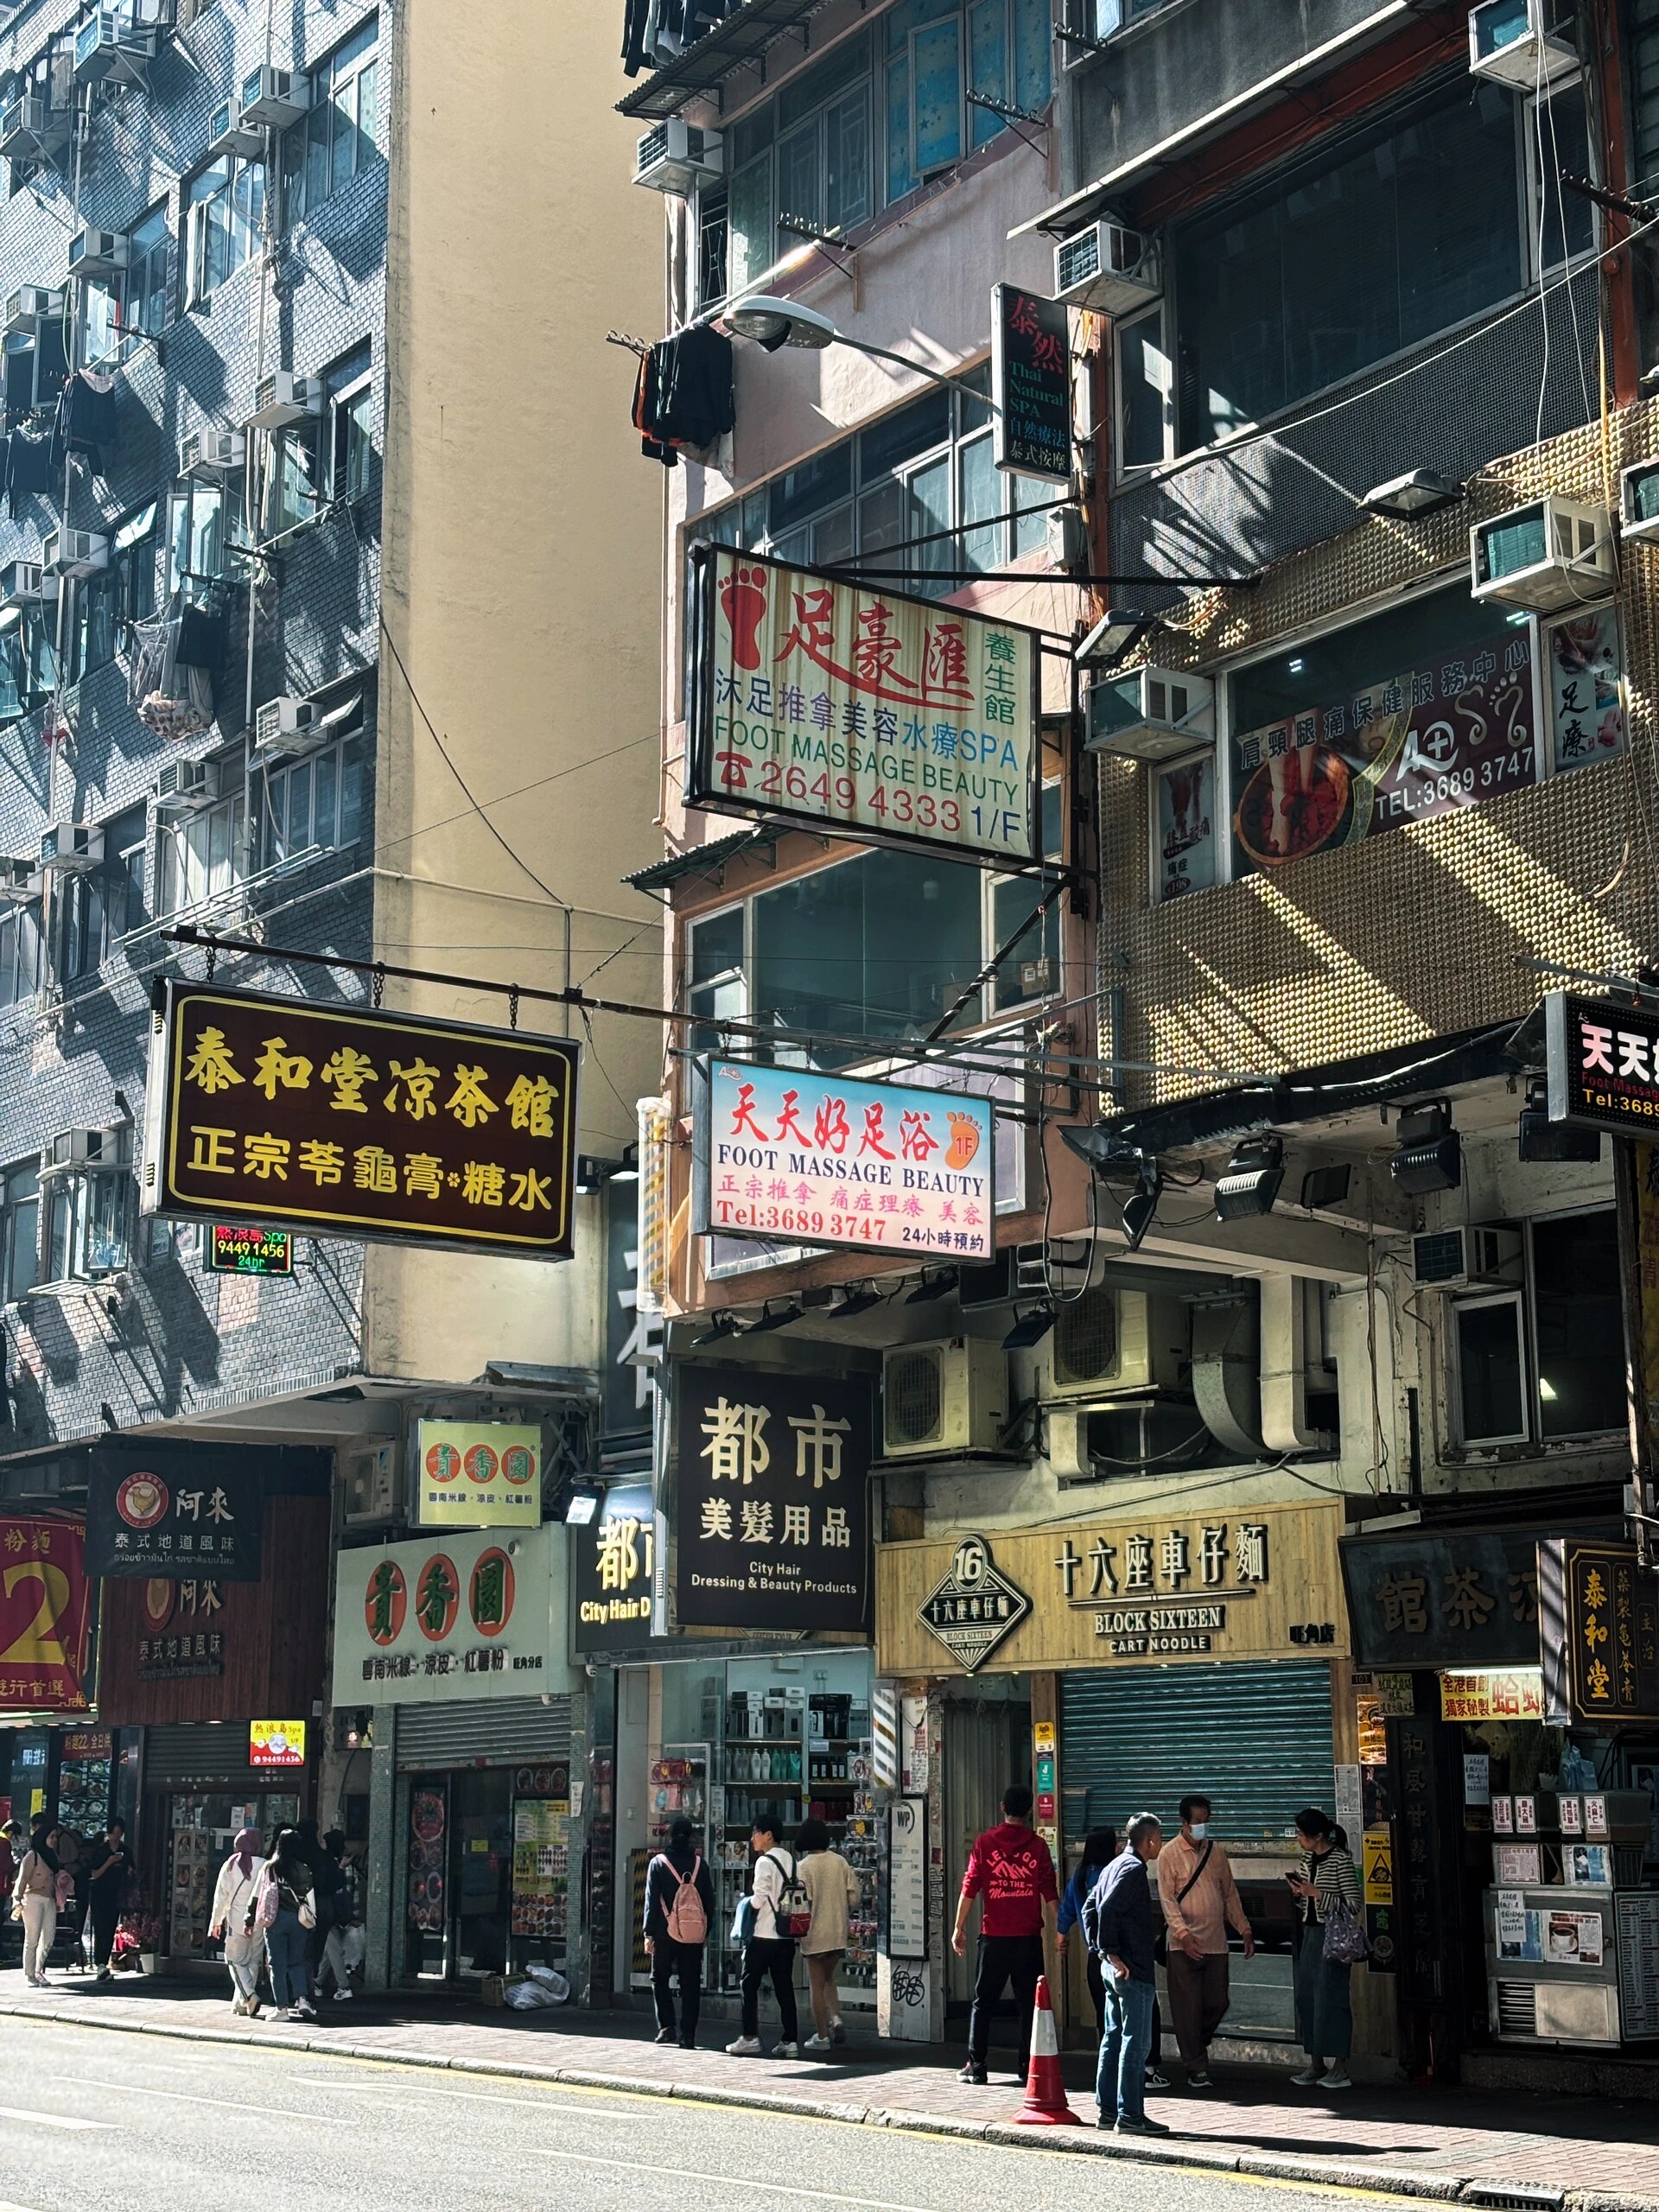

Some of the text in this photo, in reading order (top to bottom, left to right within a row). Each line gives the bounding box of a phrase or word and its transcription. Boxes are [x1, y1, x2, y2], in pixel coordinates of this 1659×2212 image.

[1007, 296, 1064, 374] 泰然
[1009, 360, 1042, 383] Thai
[1009, 379, 1064, 407] Natural
[1009, 397, 1041, 419] SPA
[1010, 417, 1065, 449] 自然療法
[1009, 440, 1066, 472] 泰式按摩
[772, 588, 976, 712] 足豪匯
[984, 631, 1017, 726] 養生館
[1241, 639, 1529, 770] 肩頸腿痛保健服務中心
[1560, 681, 1590, 760] 足療
[715, 715, 1019, 806] FOOT MASSAGE BEAUTY
[1374, 746, 1534, 822] TEL:3689 3747
[760, 760, 1021, 843] 2649 4333 1/F
[1580, 1023, 1659, 1085] 天天
[1581, 1071, 1611, 1090] Foot
[730, 1082, 940, 1163] 天天好足浴
[955, 1135, 975, 1157] 1F
[187, 1125, 553, 1212] 正宗苓龜膏 糖水
[716, 1143, 985, 1198] FOOT MASSAGE BEAUTY
[716, 1173, 984, 1226] 正宗推拿 痛症理療 美容
[716, 1199, 985, 1252] Tel:3689 3747 24小時預約
[238, 1255, 265, 1268] 24hr
[699, 1395, 852, 1489] 都市
[115, 1532, 235, 1551] 泰式地道風味
[699, 1497, 851, 1548] 美髮用品
[691, 1573, 857, 1595] Dressing & Beauty Products
[749, 1561, 802, 1577] City Hair
[955, 1547, 982, 1581] 16
[1054, 1521, 1268, 1597] 十六座車仔麵
[0, 1560, 70, 1666] 2
[580, 1600, 608, 1624] City
[609, 1598, 639, 1620] Hair
[946, 1630, 993, 1641] BLOCK SIXTEEN
[1094, 1605, 1224, 1636] BLOCK SIXTEEN
[1583, 1567, 1610, 1700] 泰和堂
[1109, 1635, 1207, 1654] CART NOODLE
[289, 1726, 302, 1734] Spa
